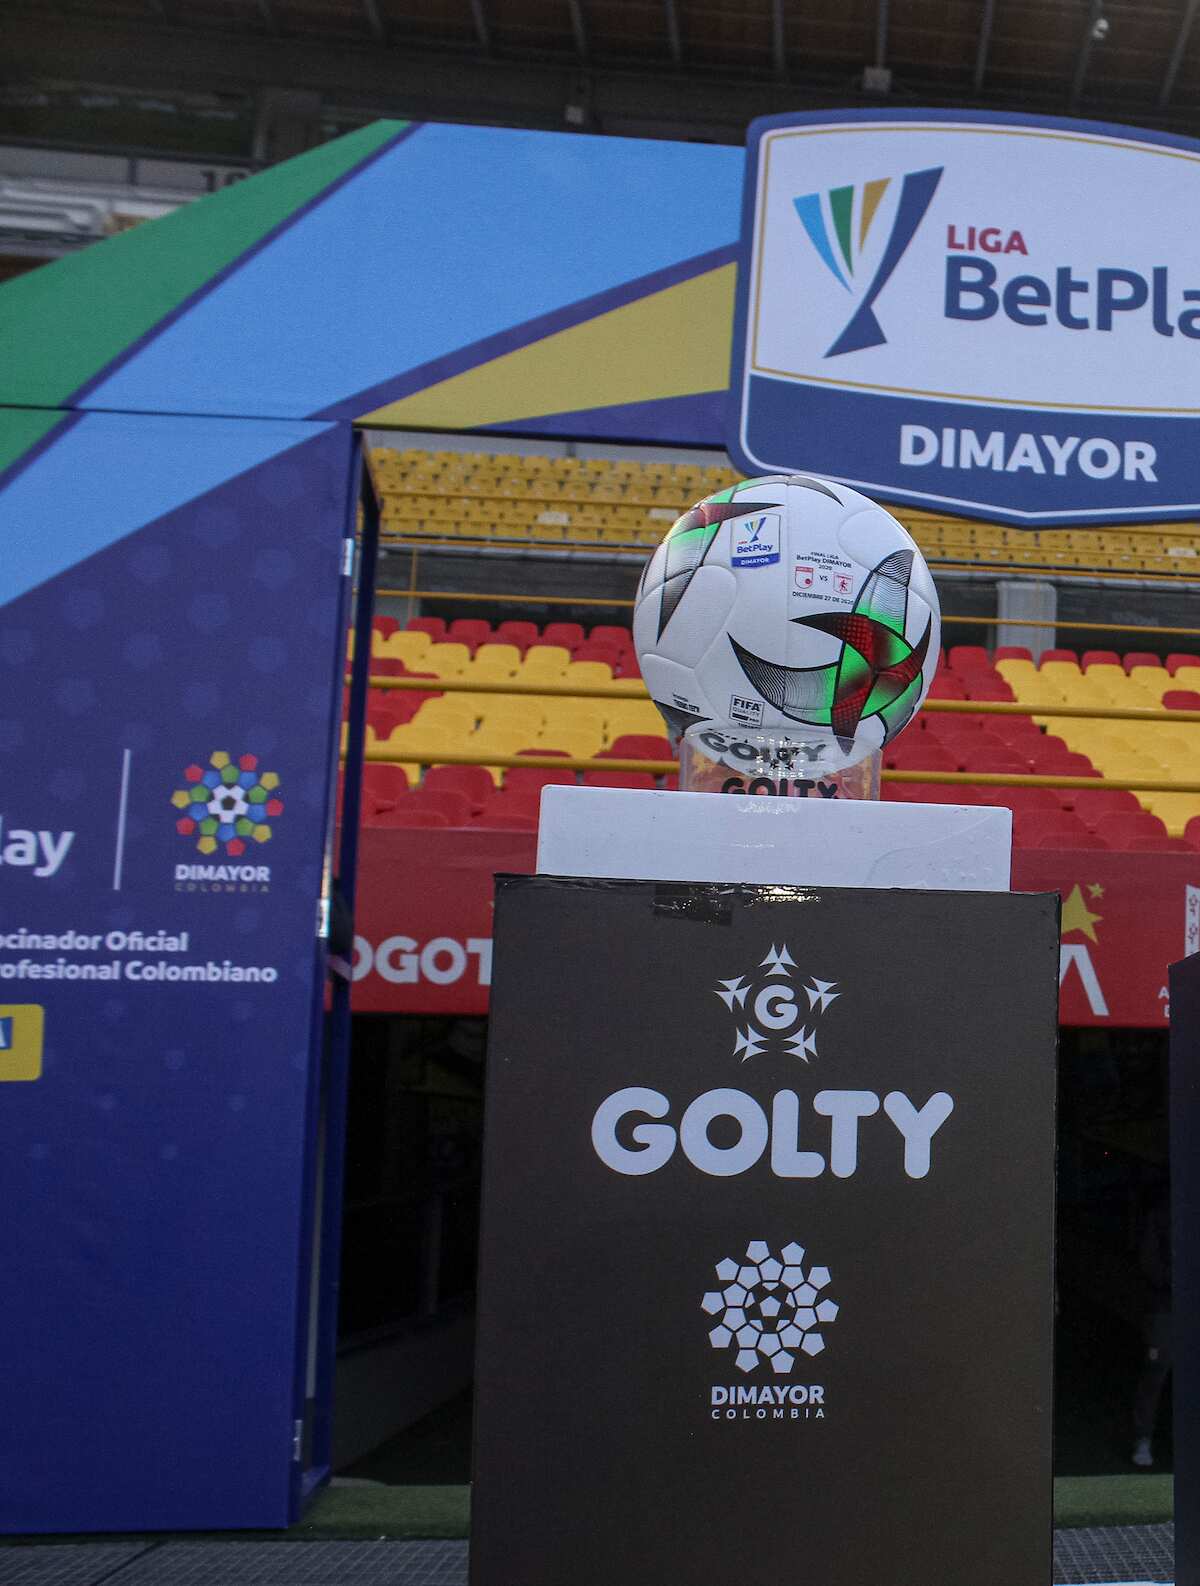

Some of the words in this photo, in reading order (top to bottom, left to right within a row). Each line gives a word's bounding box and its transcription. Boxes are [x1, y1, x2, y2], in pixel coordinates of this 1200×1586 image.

[947, 224, 1028, 256] LIGA
[900, 424, 1157, 482] DIMAYOR
[736, 543, 773, 553] BetPlay
[740, 557, 769, 566] DIMAYOR
[796, 554, 821, 563] BetPlay
[822, 558, 852, 568] DIMAYOR
[792, 591, 823, 600] DICIEMBRE
[734, 698, 760, 711] FIFA
[700, 733, 826, 763] GOY
[0, 815, 75, 877] ay
[175, 864, 270, 882] DIMAYOR
[175, 882, 270, 892] COLOMBIA
[0, 928, 102, 950] cinador
[105, 930, 189, 951] Oficial
[125, 960, 278, 983] Colombiano
[591, 1087, 954, 1179] GOLTY
[711, 1385, 825, 1405] DIMAYOR
[711, 1408, 825, 1420] COLOMBIA
